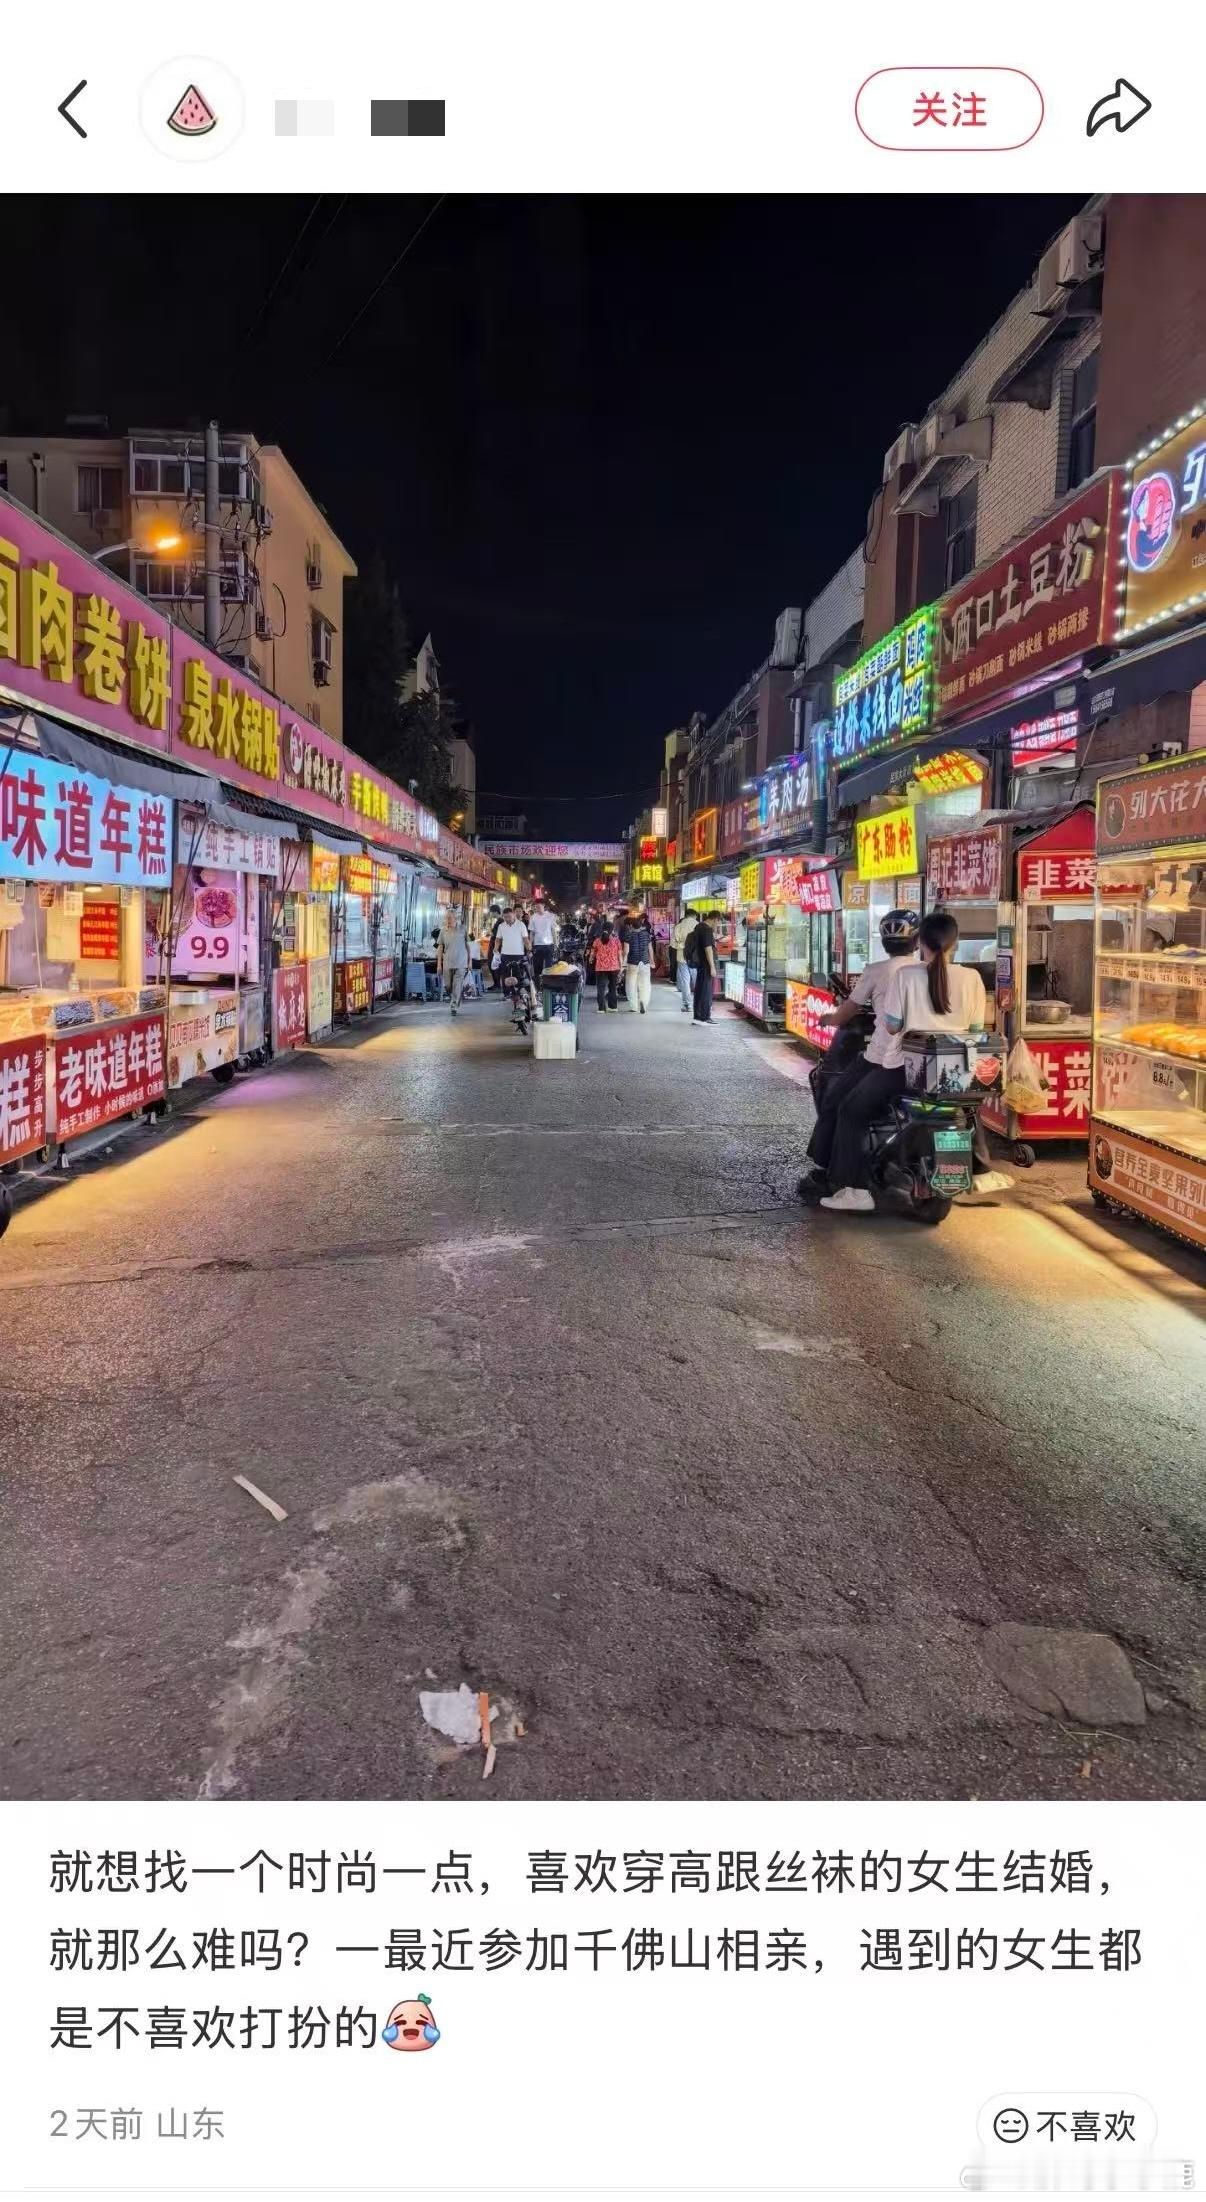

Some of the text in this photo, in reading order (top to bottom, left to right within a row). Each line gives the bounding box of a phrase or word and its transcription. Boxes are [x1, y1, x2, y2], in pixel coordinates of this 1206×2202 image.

[182, 659, 280, 781] 泉水锅贴
[0, 768, 167, 875] 味道年糕
[484, 845, 569, 856] 民族市场欢迎您
[861, 816, 912, 868] 广东肠粉
[190, 935, 229, 959] 9.9
[34, 1050, 43, 1138] 步步高升
[60, 1023, 163, 1108] 老味道年糕
[0, 1053, 30, 1151] 糕
[60, 1105, 101, 1135] 纯手工制作
[1114, 1147, 1206, 1207] 营养全麦坚果列
